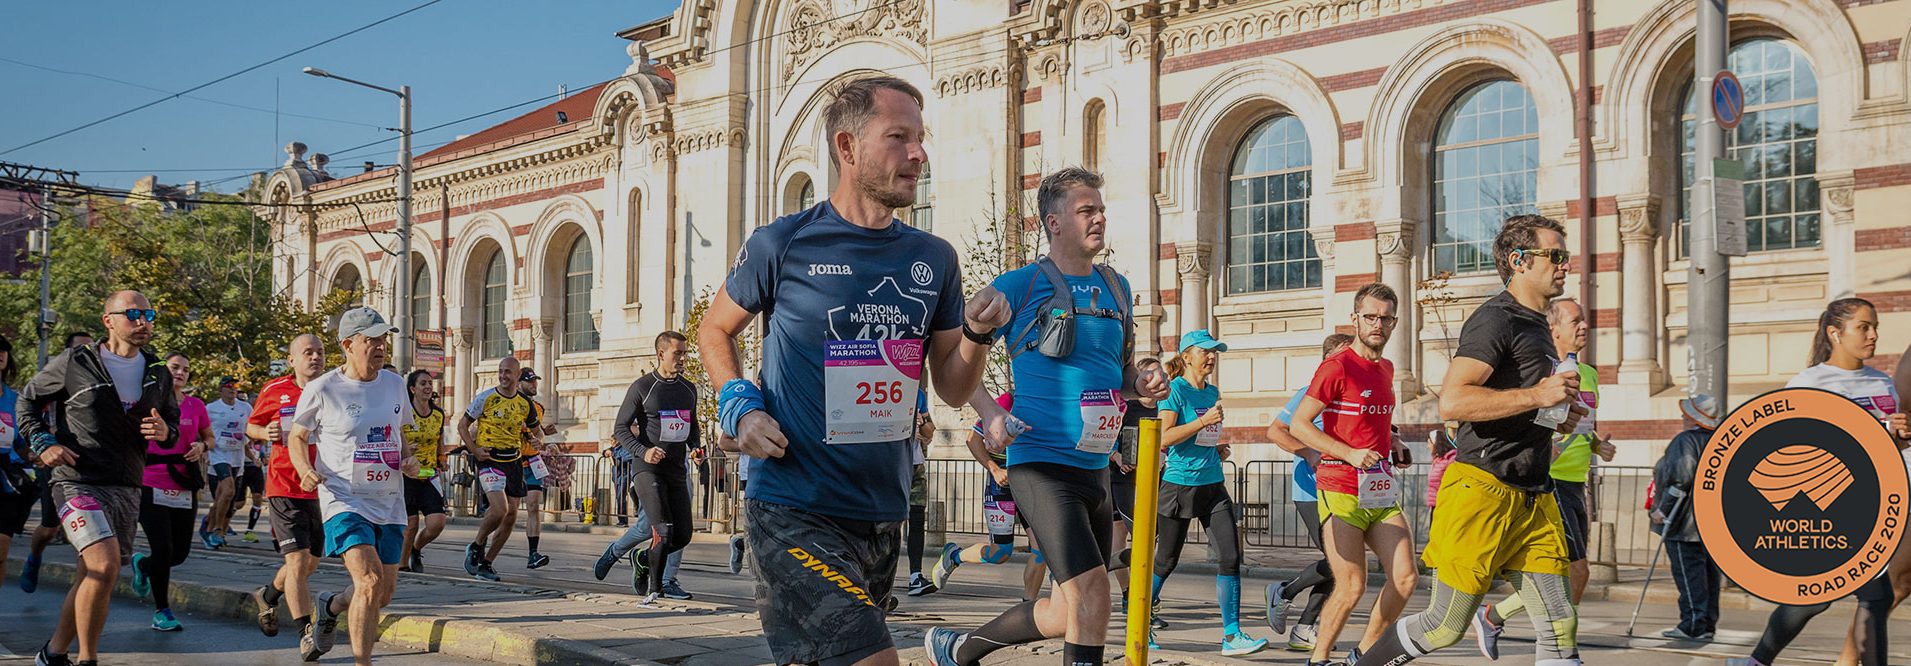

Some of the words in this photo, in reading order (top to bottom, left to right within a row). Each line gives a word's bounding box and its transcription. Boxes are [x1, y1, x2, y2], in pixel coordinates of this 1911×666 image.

[857, 304, 901, 314] VERONA
[850, 313, 910, 324] MARATHON
[855, 380, 903, 405] 256
[1360, 389, 1372, 398] 4F
[870, 409, 892, 418] MAIK
[669, 422, 685, 431] 497
[1098, 415, 1121, 431] 249
[366, 470, 390, 481] 569
[1369, 480, 1391, 491] 266
[70, 515, 87, 532] 95
[990, 514, 1005, 523] 214
